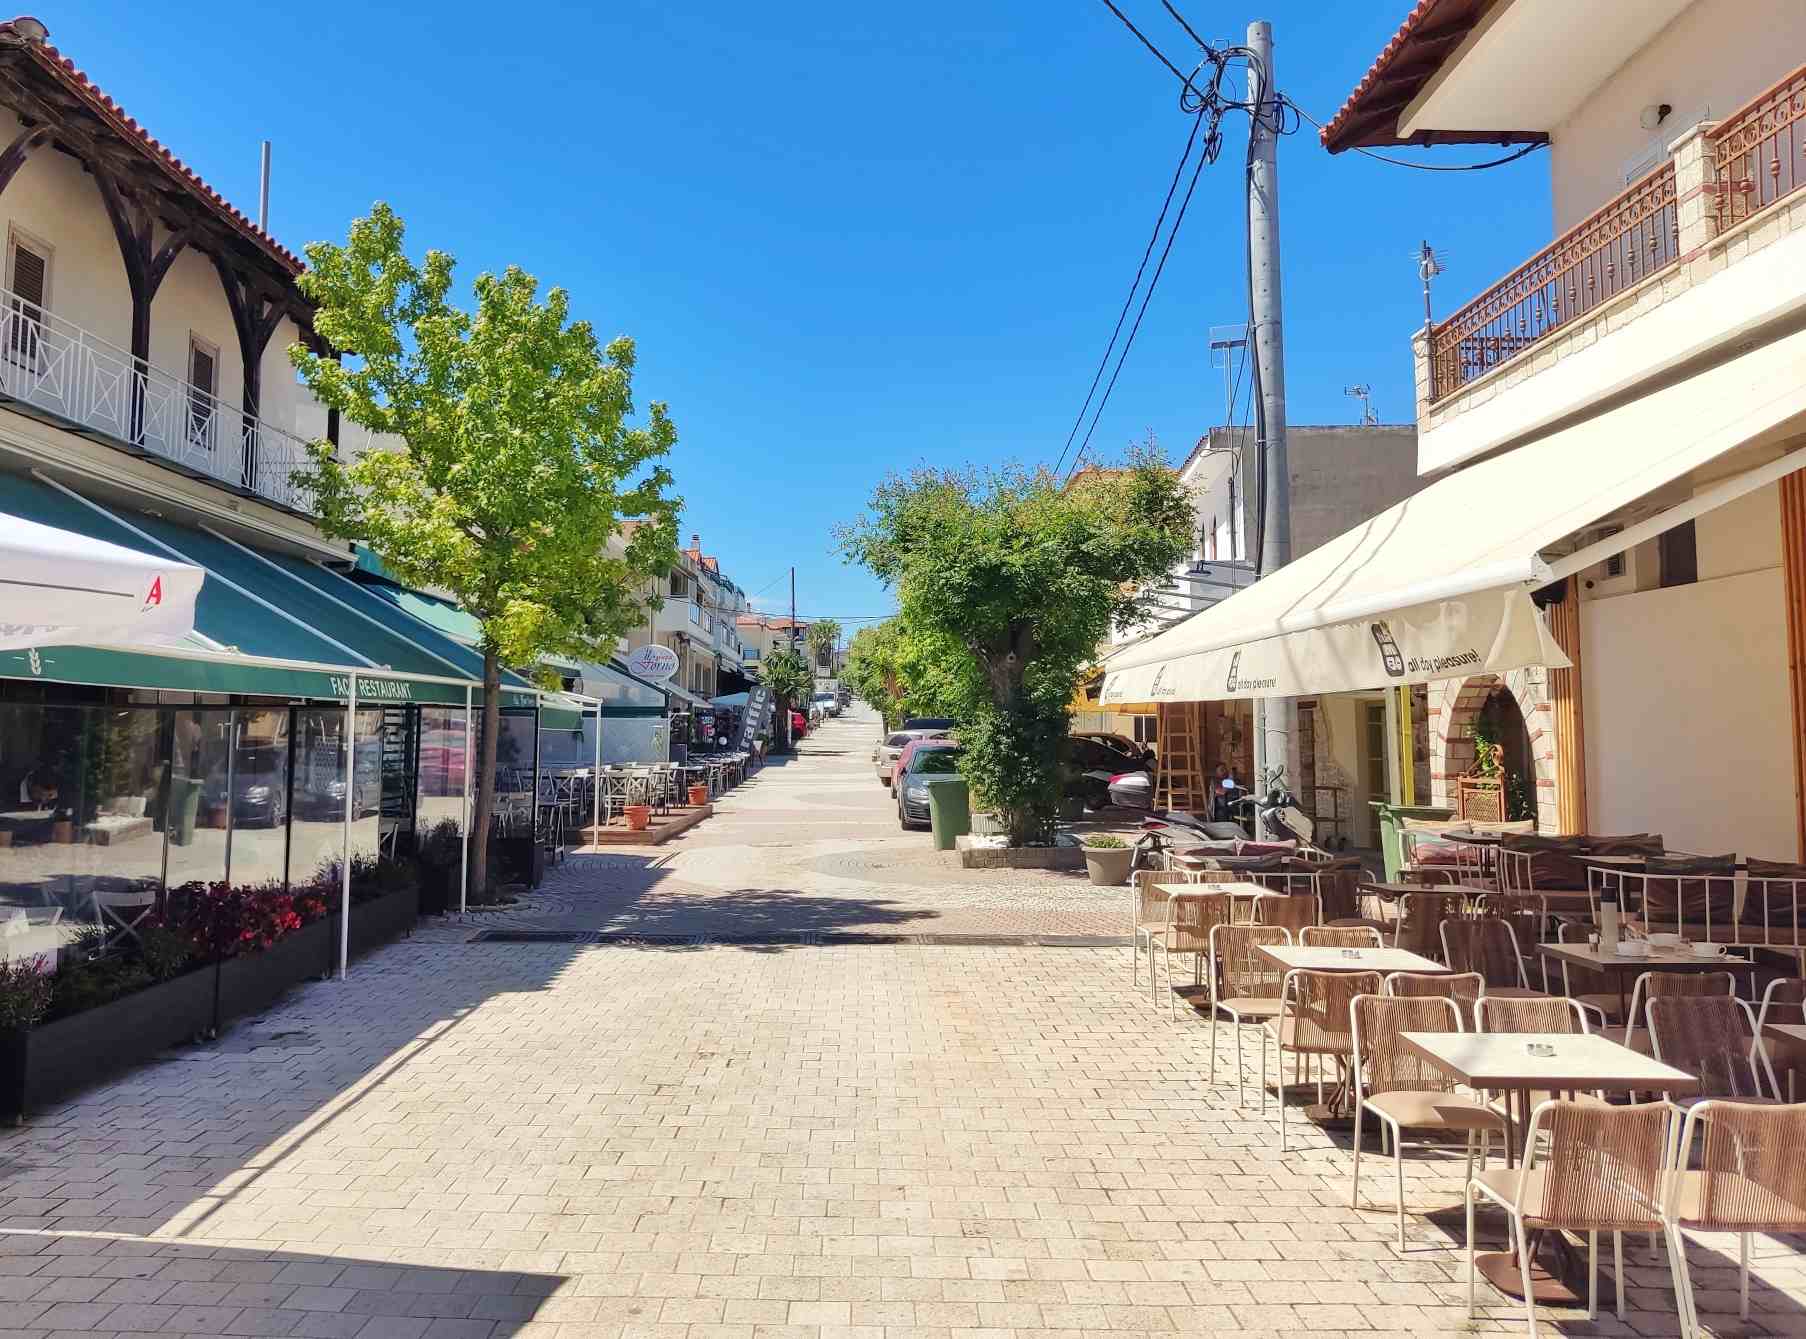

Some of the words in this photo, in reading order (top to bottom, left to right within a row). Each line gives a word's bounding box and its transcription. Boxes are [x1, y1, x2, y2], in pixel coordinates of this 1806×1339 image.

[145, 575, 163, 605] A
[1408, 656, 1420, 673] all
[1420, 657, 1434, 673] day
[1434, 648, 1482, 673] pleasure!
[330, 677, 355, 696] FAC
[358, 679, 412, 699] RESTAURANT
